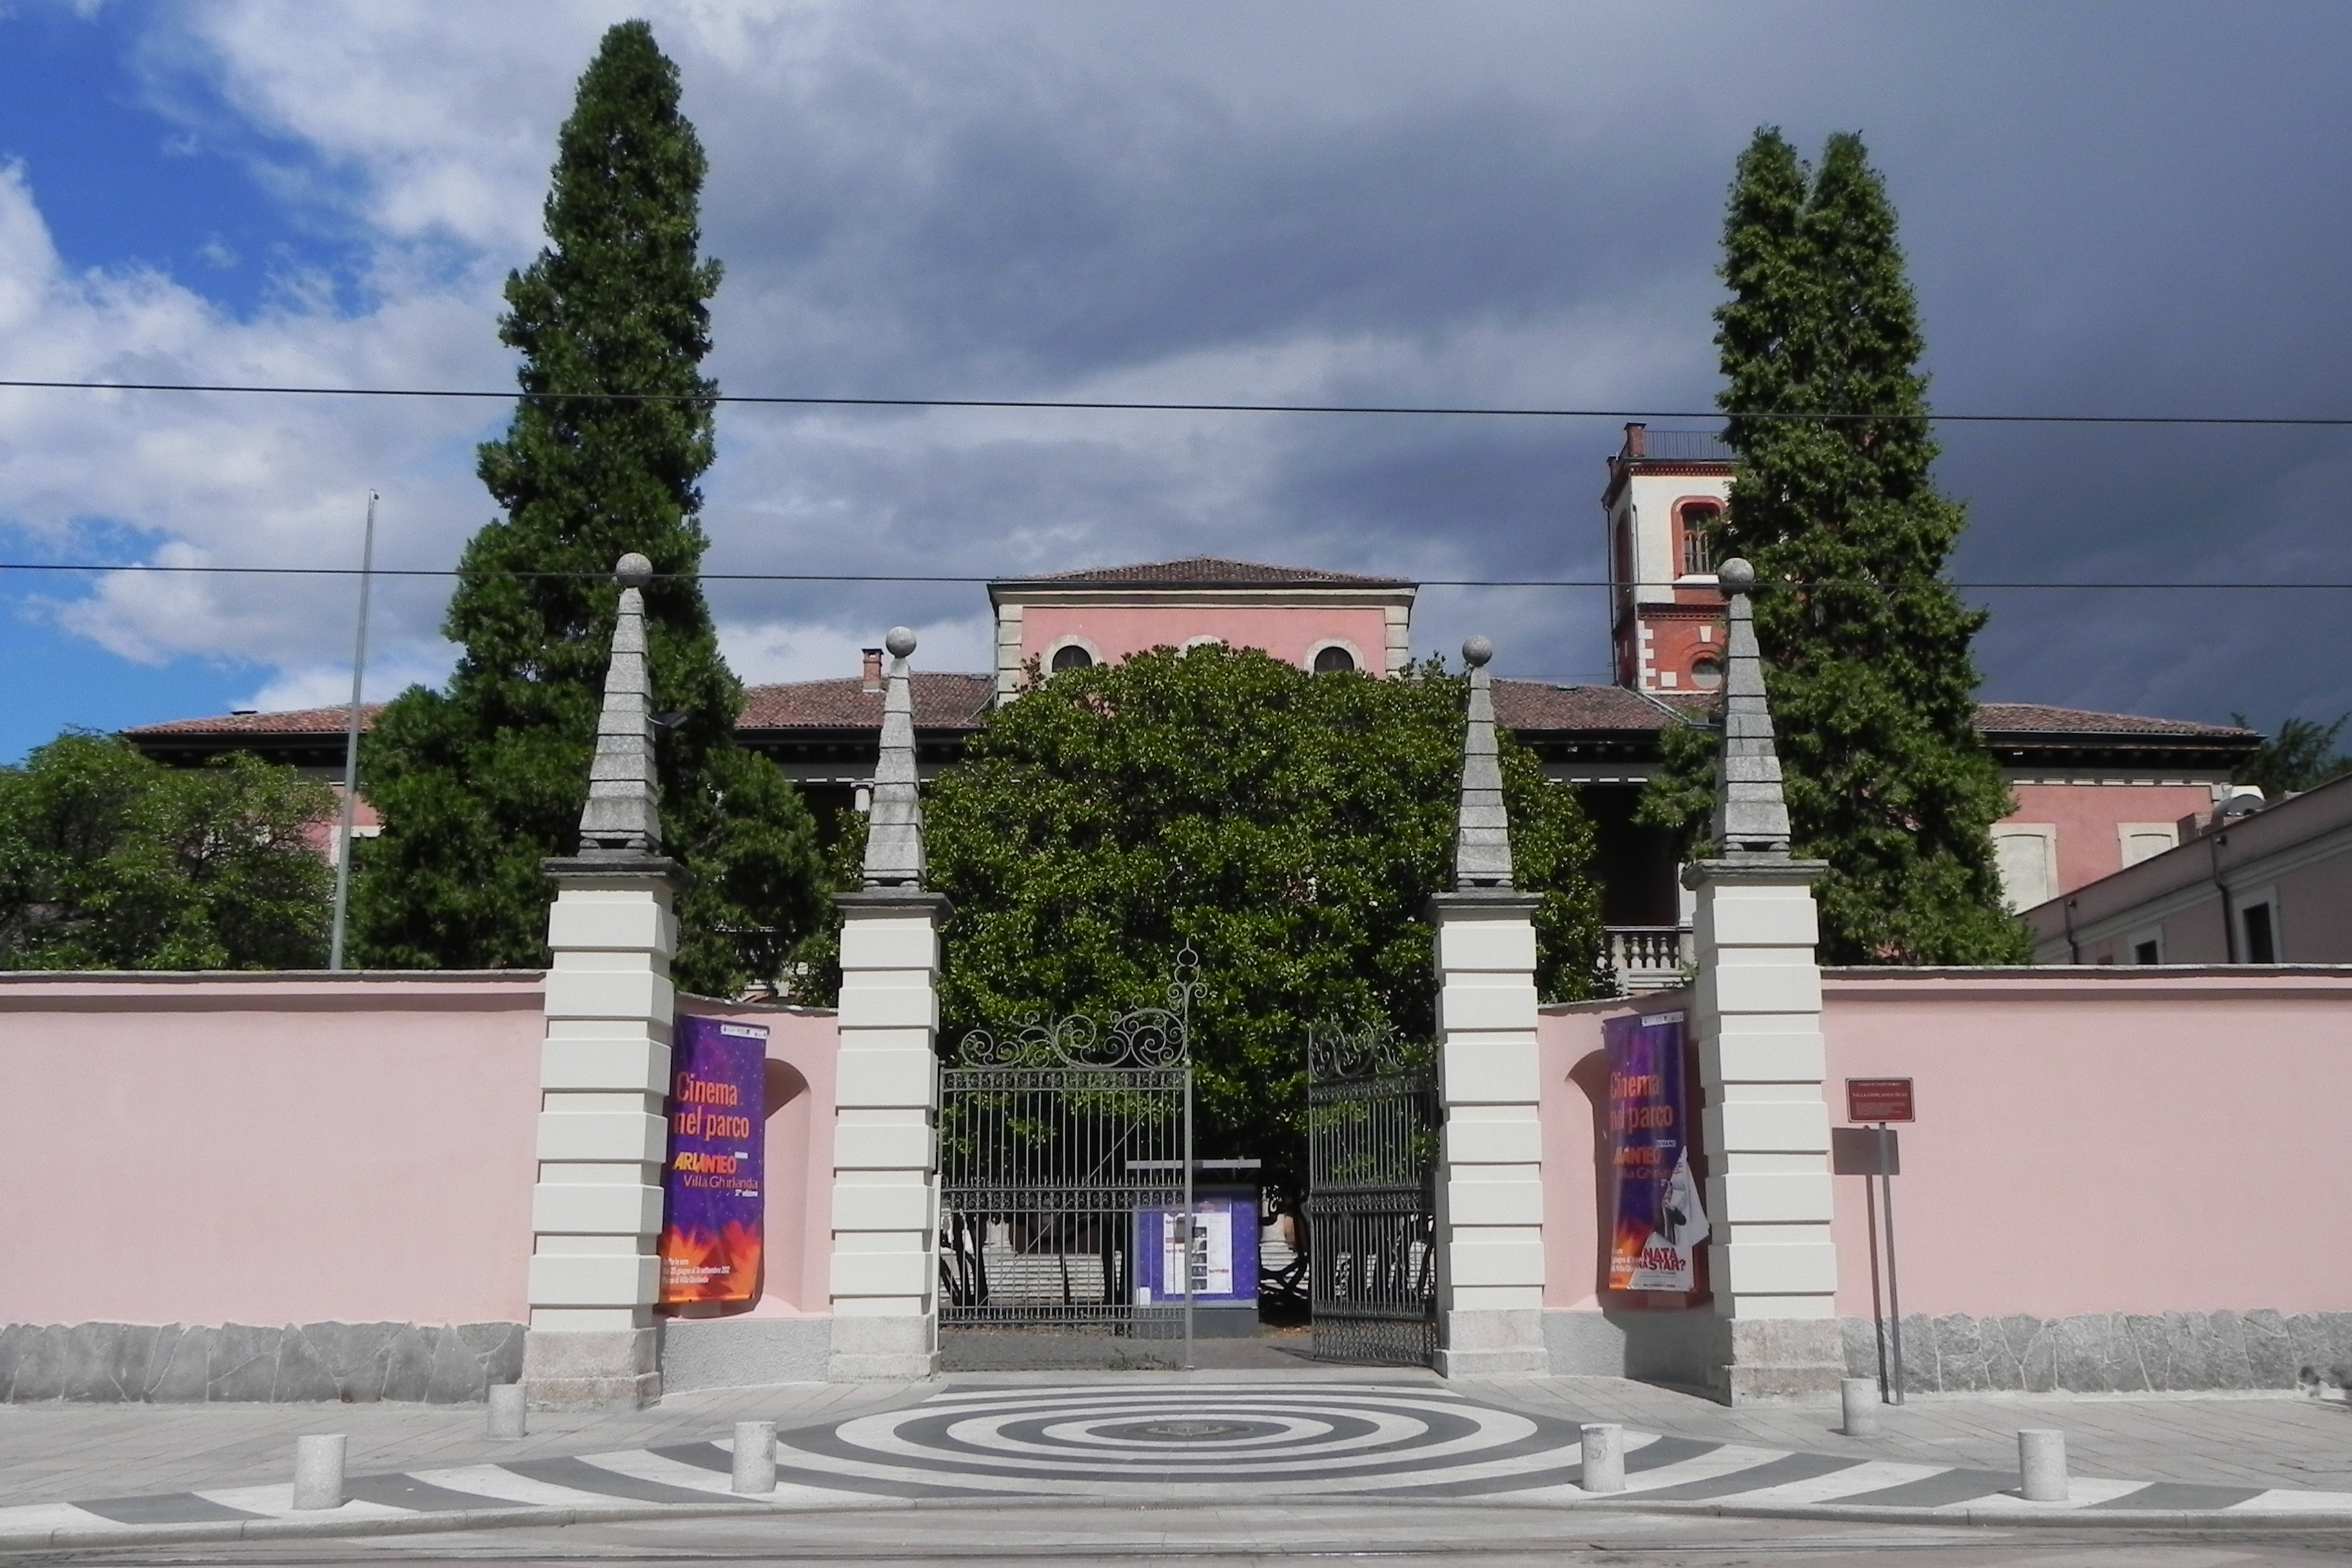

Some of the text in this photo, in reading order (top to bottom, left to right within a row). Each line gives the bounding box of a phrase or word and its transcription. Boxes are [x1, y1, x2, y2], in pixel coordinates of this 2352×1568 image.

[677, 1072, 738, 1106] Cinema
[1611, 1072, 1660, 1099] Cinema
[674, 1106, 749, 1142] nel parco
[1629, 1106, 1673, 1133] parco
[683, 1175, 758, 1189] Villa Ghirlanda
[1643, 1248, 1678, 1262] NATA
